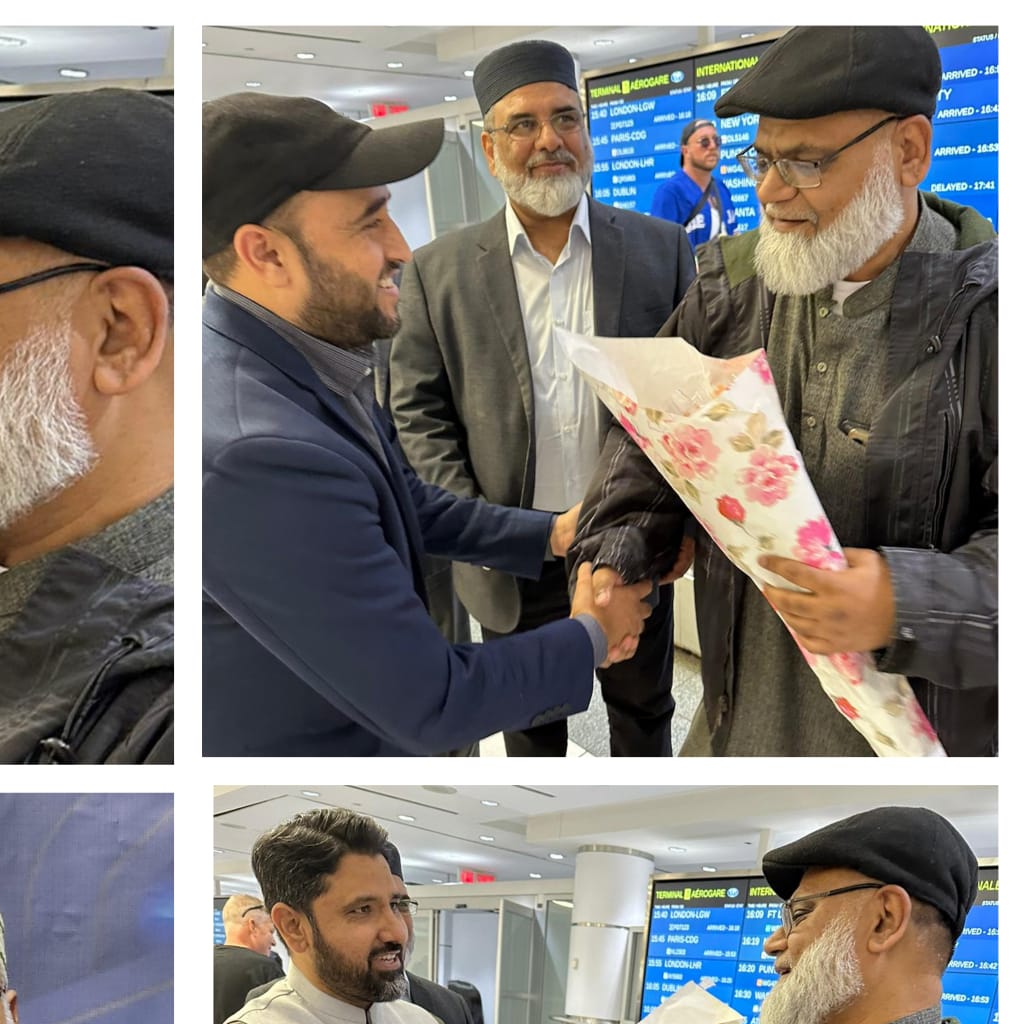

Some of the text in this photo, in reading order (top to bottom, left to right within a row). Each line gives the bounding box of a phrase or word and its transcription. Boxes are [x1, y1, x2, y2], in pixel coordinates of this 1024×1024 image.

[941, 67, 978, 80] ARRIVED
[937, 107, 975, 119] ARRIVED
[720, 117, 739, 129] NEW
[934, 145, 971, 157] ARRIVED
[930, 180, 995, 192] DELAYED 17:41
